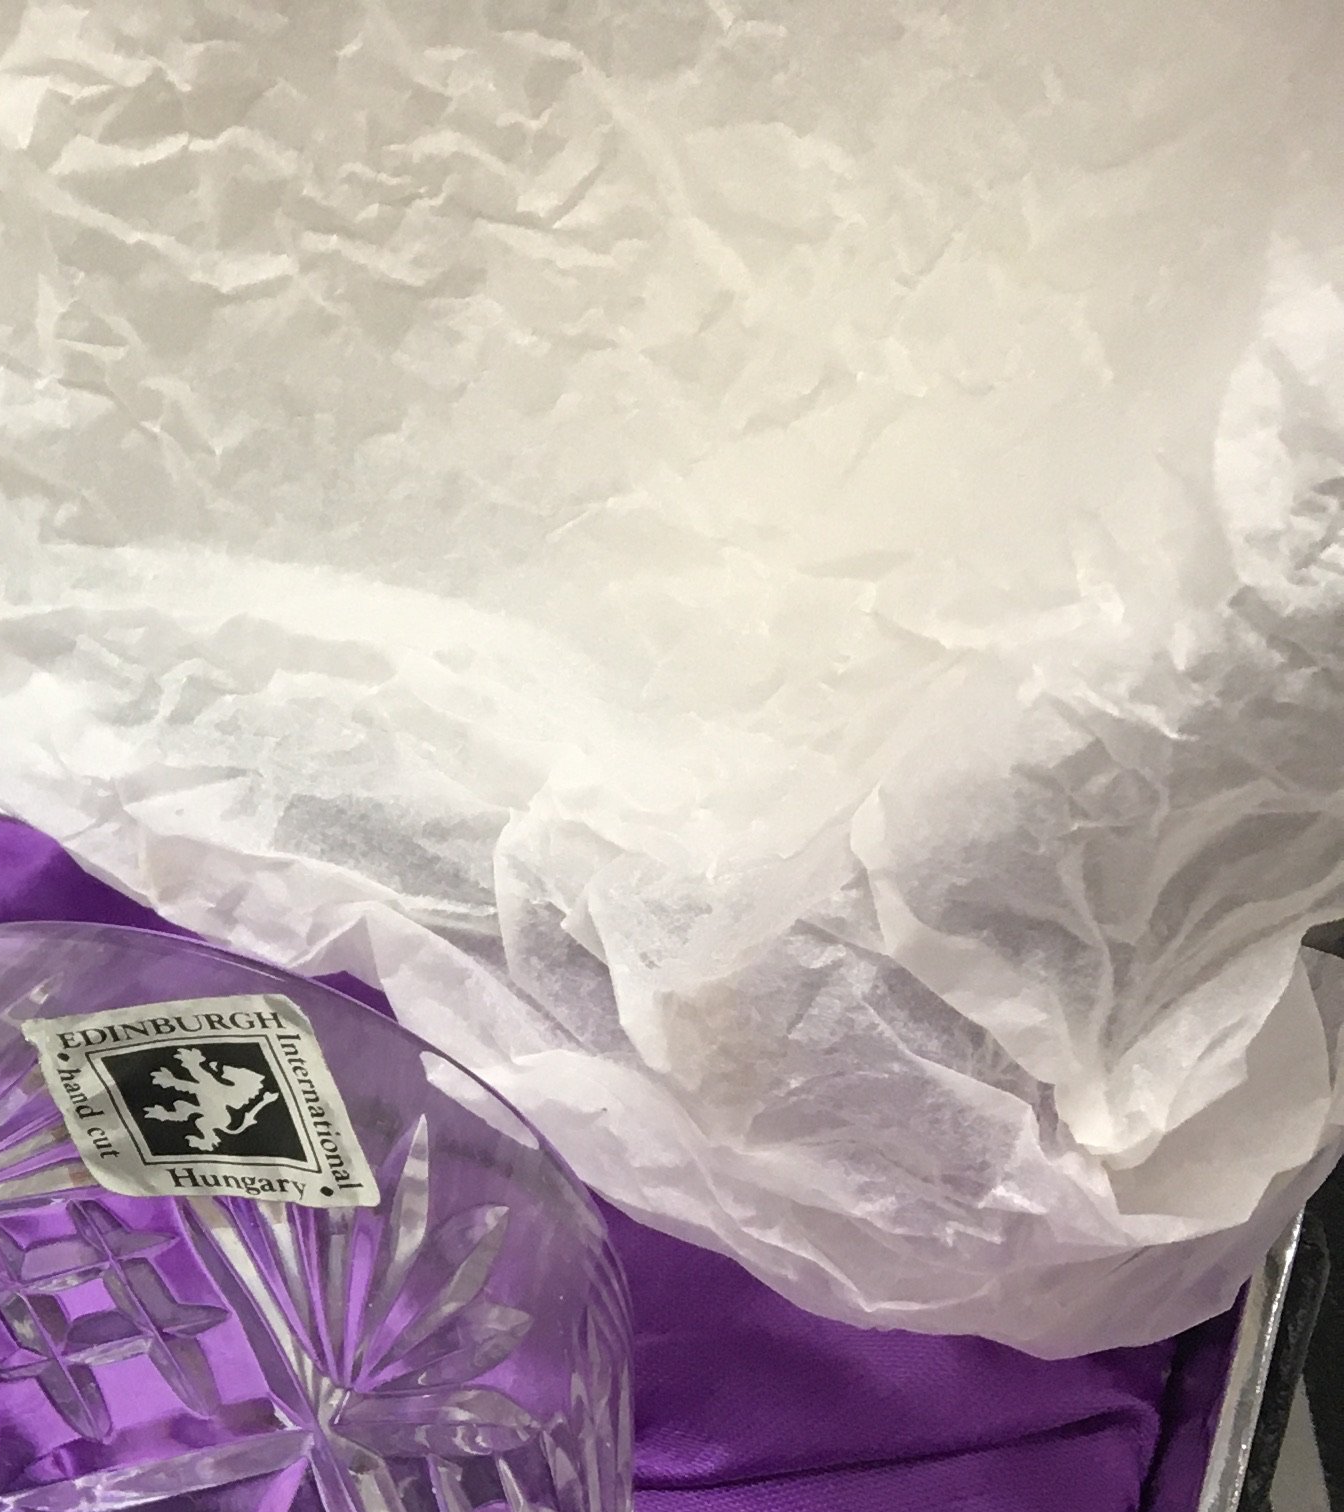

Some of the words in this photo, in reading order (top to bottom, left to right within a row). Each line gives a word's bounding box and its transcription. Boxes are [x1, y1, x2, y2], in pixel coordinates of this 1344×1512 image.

[56, 1011, 287, 1050] EDINBURGH
[56, 1067, 104, 1120] hand
[86, 1126, 121, 1160] cut
[276, 1032, 365, 1191] International
[167, 1167, 307, 1200] Hungary
